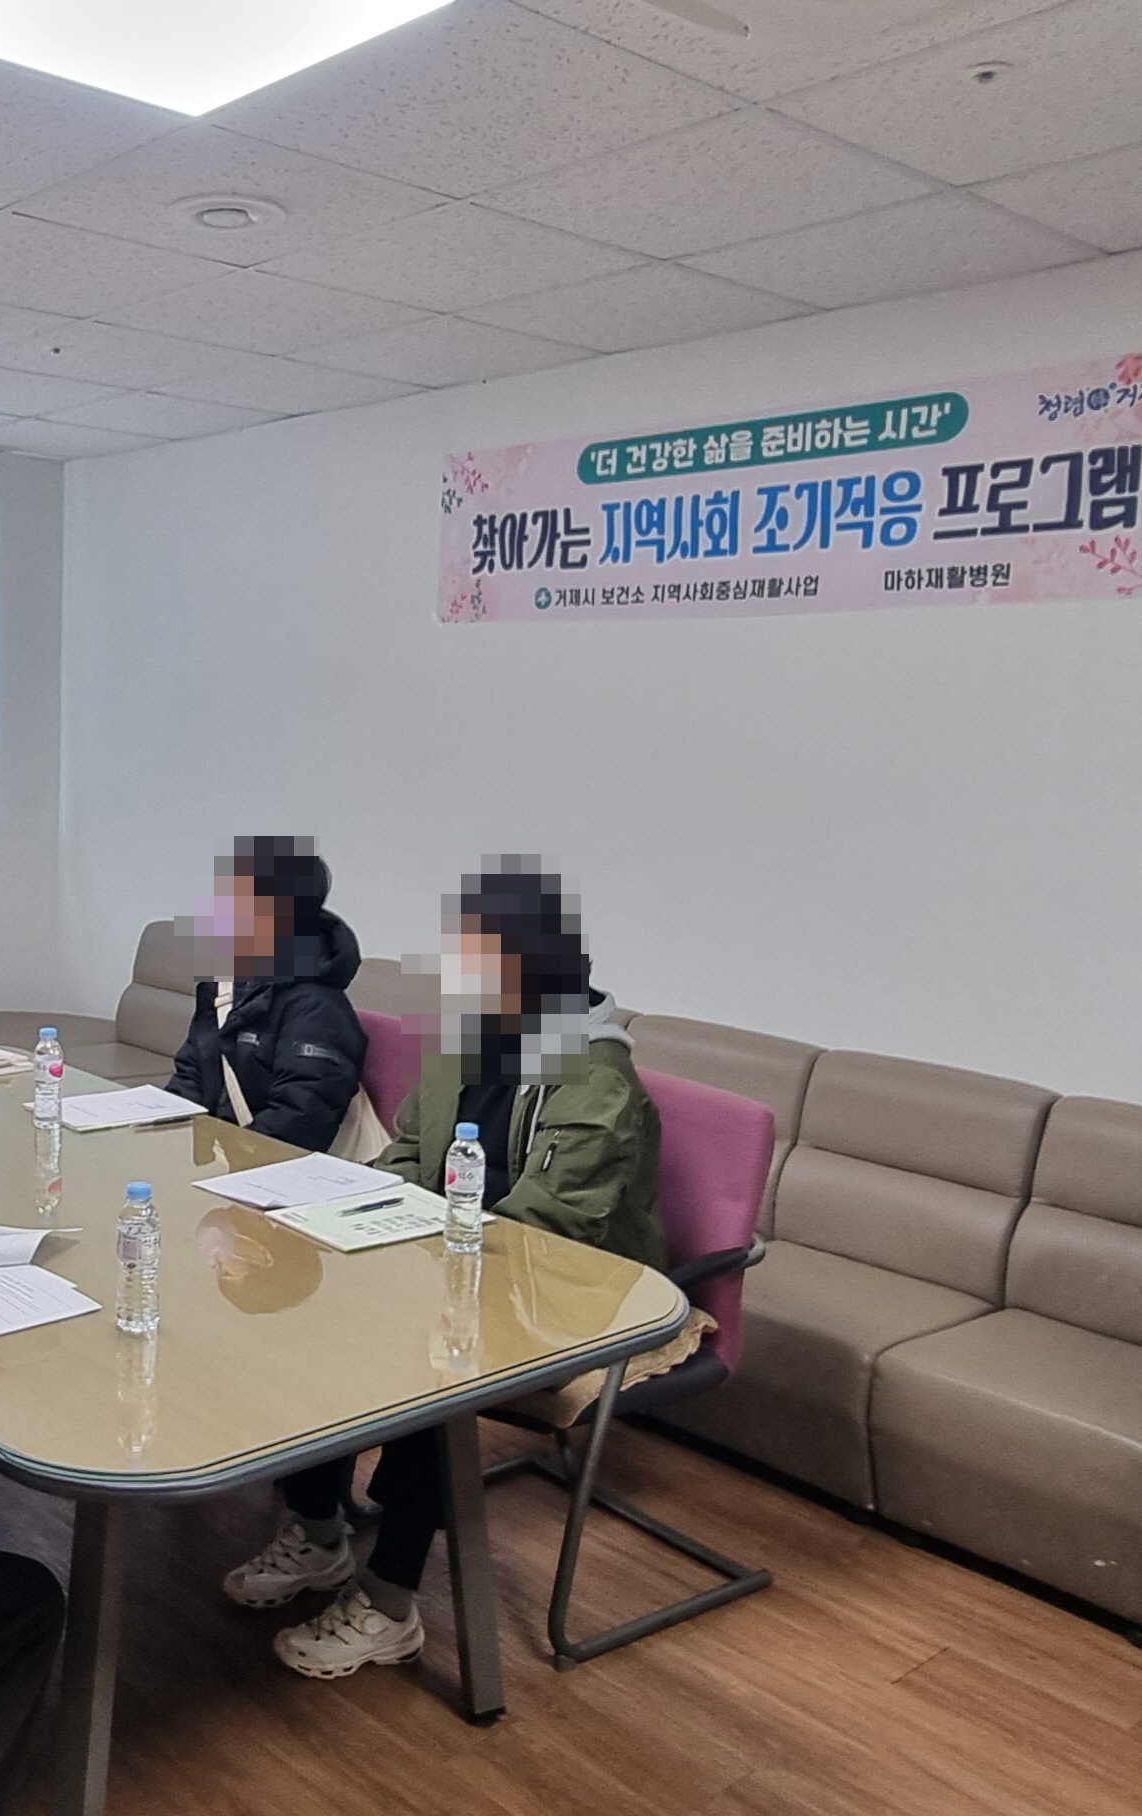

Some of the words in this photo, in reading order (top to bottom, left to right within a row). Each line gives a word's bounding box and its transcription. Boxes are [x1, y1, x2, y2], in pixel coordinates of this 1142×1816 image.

[590, 449, 618, 477] '더
[626, 437, 697, 475] 건강한
[703, 429, 754, 465] 삶을
[761, 415, 871, 457] 준비하는
[878, 401, 951, 440] 시간'
[471, 507, 591, 575] 찾아가는
[598, 490, 741, 565] 지역사회
[752, 470, 923, 554] 조기적응
[933, 443, 1142, 540] 프로그램
[554, 587, 596, 608] 거제시
[601, 585, 645, 605] 보건소
[651, 574, 819, 603] 지역사회중심재활사업
[884, 562, 1011, 592] 마하재활병원
